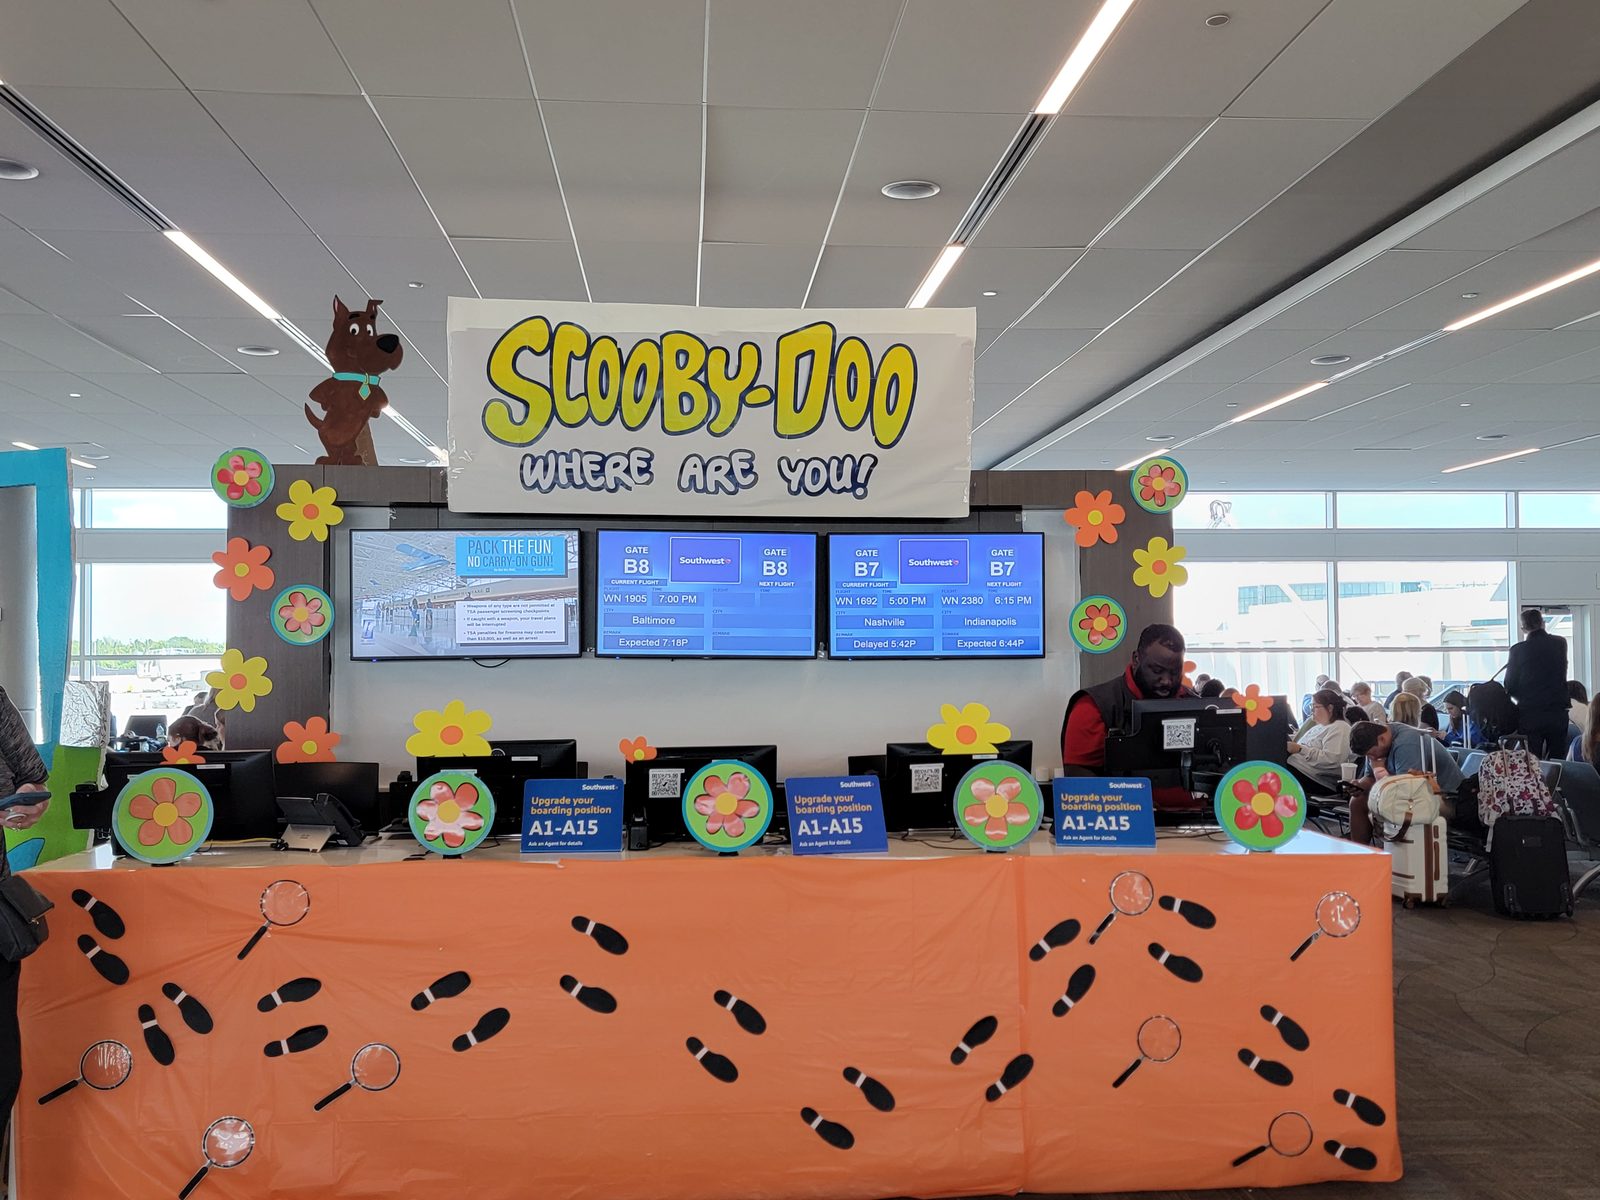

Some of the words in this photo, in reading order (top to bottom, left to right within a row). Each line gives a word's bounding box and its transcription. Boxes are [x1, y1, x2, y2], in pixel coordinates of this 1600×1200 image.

[482, 315, 917, 449] SCOOBY-DOO
[520, 448, 654, 493] WHERE
[678, 449, 758, 495] ARE
[777, 453, 878, 499] YOU!
[468, 540, 498, 554] PACK
[502, 540, 524, 554] THE
[625, 546, 648, 554] GATE
[855, 549, 878, 557] GATE
[991, 549, 1014, 557] GATE
[467, 556, 480, 567] NO
[483, 556, 527, 567] CARRY-ON
[531, 556, 553, 567] GUN!
[679, 556, 725, 565] Southwest
[908, 558, 953, 566] Southwest
[624, 559, 649, 574] B8
[763, 561, 788, 576] B8
[855, 562, 879, 577] B7
[990, 561, 1015, 576] B7
[604, 594, 621, 603] WN
[625, 594, 647, 603] 1905
[659, 595, 679, 603] 7:00
[682, 595, 697, 603] PM
[836, 597, 853, 605] WN
[856, 597, 877, 605] 1692
[889, 597, 908, 605] 5:00
[911, 597, 926, 605] PM
[941, 596, 959, 605] WN
[961, 596, 984, 605] 2380
[995, 596, 1014, 605] 6:15
[1017, 596, 1032, 605] PM
[632, 616, 676, 624] Baltimore
[864, 618, 905, 626] Nashville
[964, 617, 1017, 627] Indianapolis
[619, 638, 660, 648] Expected
[662, 638, 689, 647] 7:18P
[853, 640, 888, 650] Delayed
[891, 640, 916, 648] 5:42P
[957, 640, 997, 649] Expected
[999, 640, 1024, 648] 6:44P
[531, 796, 570, 806] Upgrade
[573, 797, 594, 806] your
[794, 794, 832, 805] Upgrade
[834, 795, 854, 804] your
[1061, 793, 1099, 802] Upgrade
[530, 806, 572, 816] boarding
[574, 806, 611, 815] position
[795, 805, 835, 815] boarding
[837, 803, 872, 814] position
[1061, 803, 1102, 812] boarding
[1104, 803, 1141, 812] position
[529, 820, 598, 835] A1-A15
[798, 818, 863, 835] A1-A15
[1062, 816, 1130, 831] A1-A15
